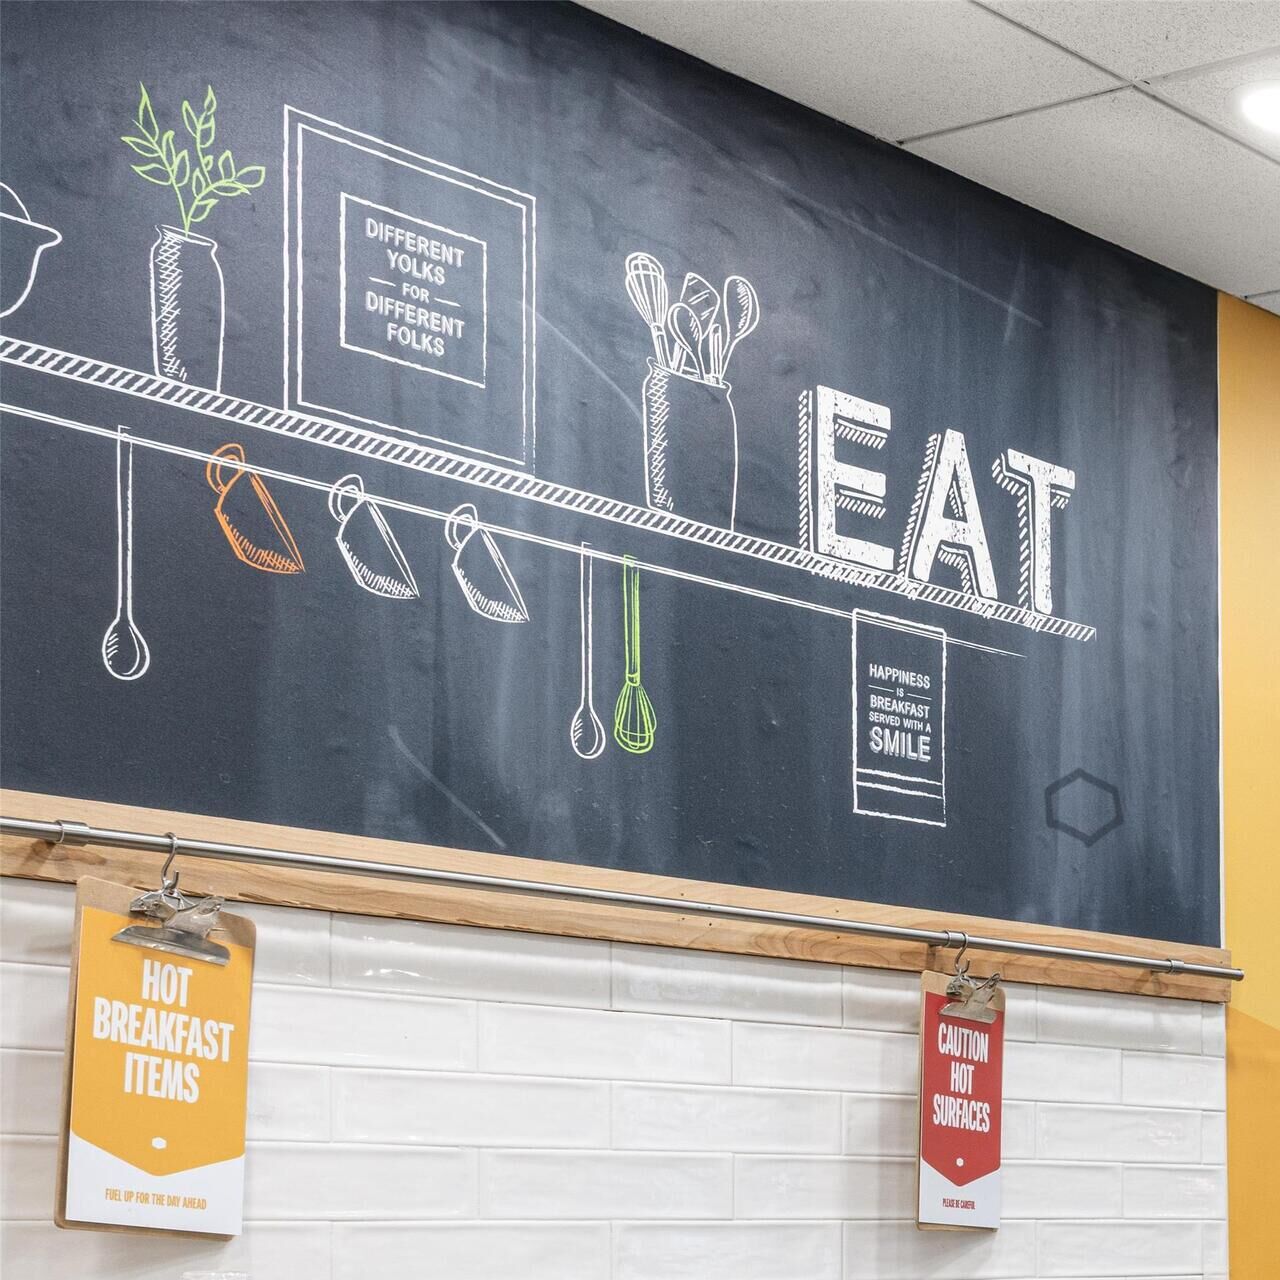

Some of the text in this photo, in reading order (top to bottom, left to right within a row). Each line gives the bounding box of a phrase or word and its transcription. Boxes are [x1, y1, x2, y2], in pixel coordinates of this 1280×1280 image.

[365, 217, 465, 268] DIFFERENT
[386, 249, 446, 286] YOLKS
[402, 283, 430, 304] FOR
[365, 290, 465, 339] DIFFERENT
[386, 322, 445, 358] FOLKS
[799, 384, 1076, 616] EAT
[869, 663, 931, 690] HAPPINESS
[896, 687, 904, 698] IS
[868, 711, 932, 734] SERVED WITH A
[869, 694, 930, 719] BREAKFAST
[868, 726, 932, 763] SMILE
[142, 958, 193, 1008] HOT
[93, 996, 235, 1062] BREAKFAST
[938, 1022, 989, 1063] CAUTION
[124, 1051, 200, 1104] ITEMS
[950, 1061, 975, 1095] HOT
[933, 1093, 991, 1133] SURFACES
[105, 1188, 207, 1210] FUEL UP FOR THE DAY AHEAD
